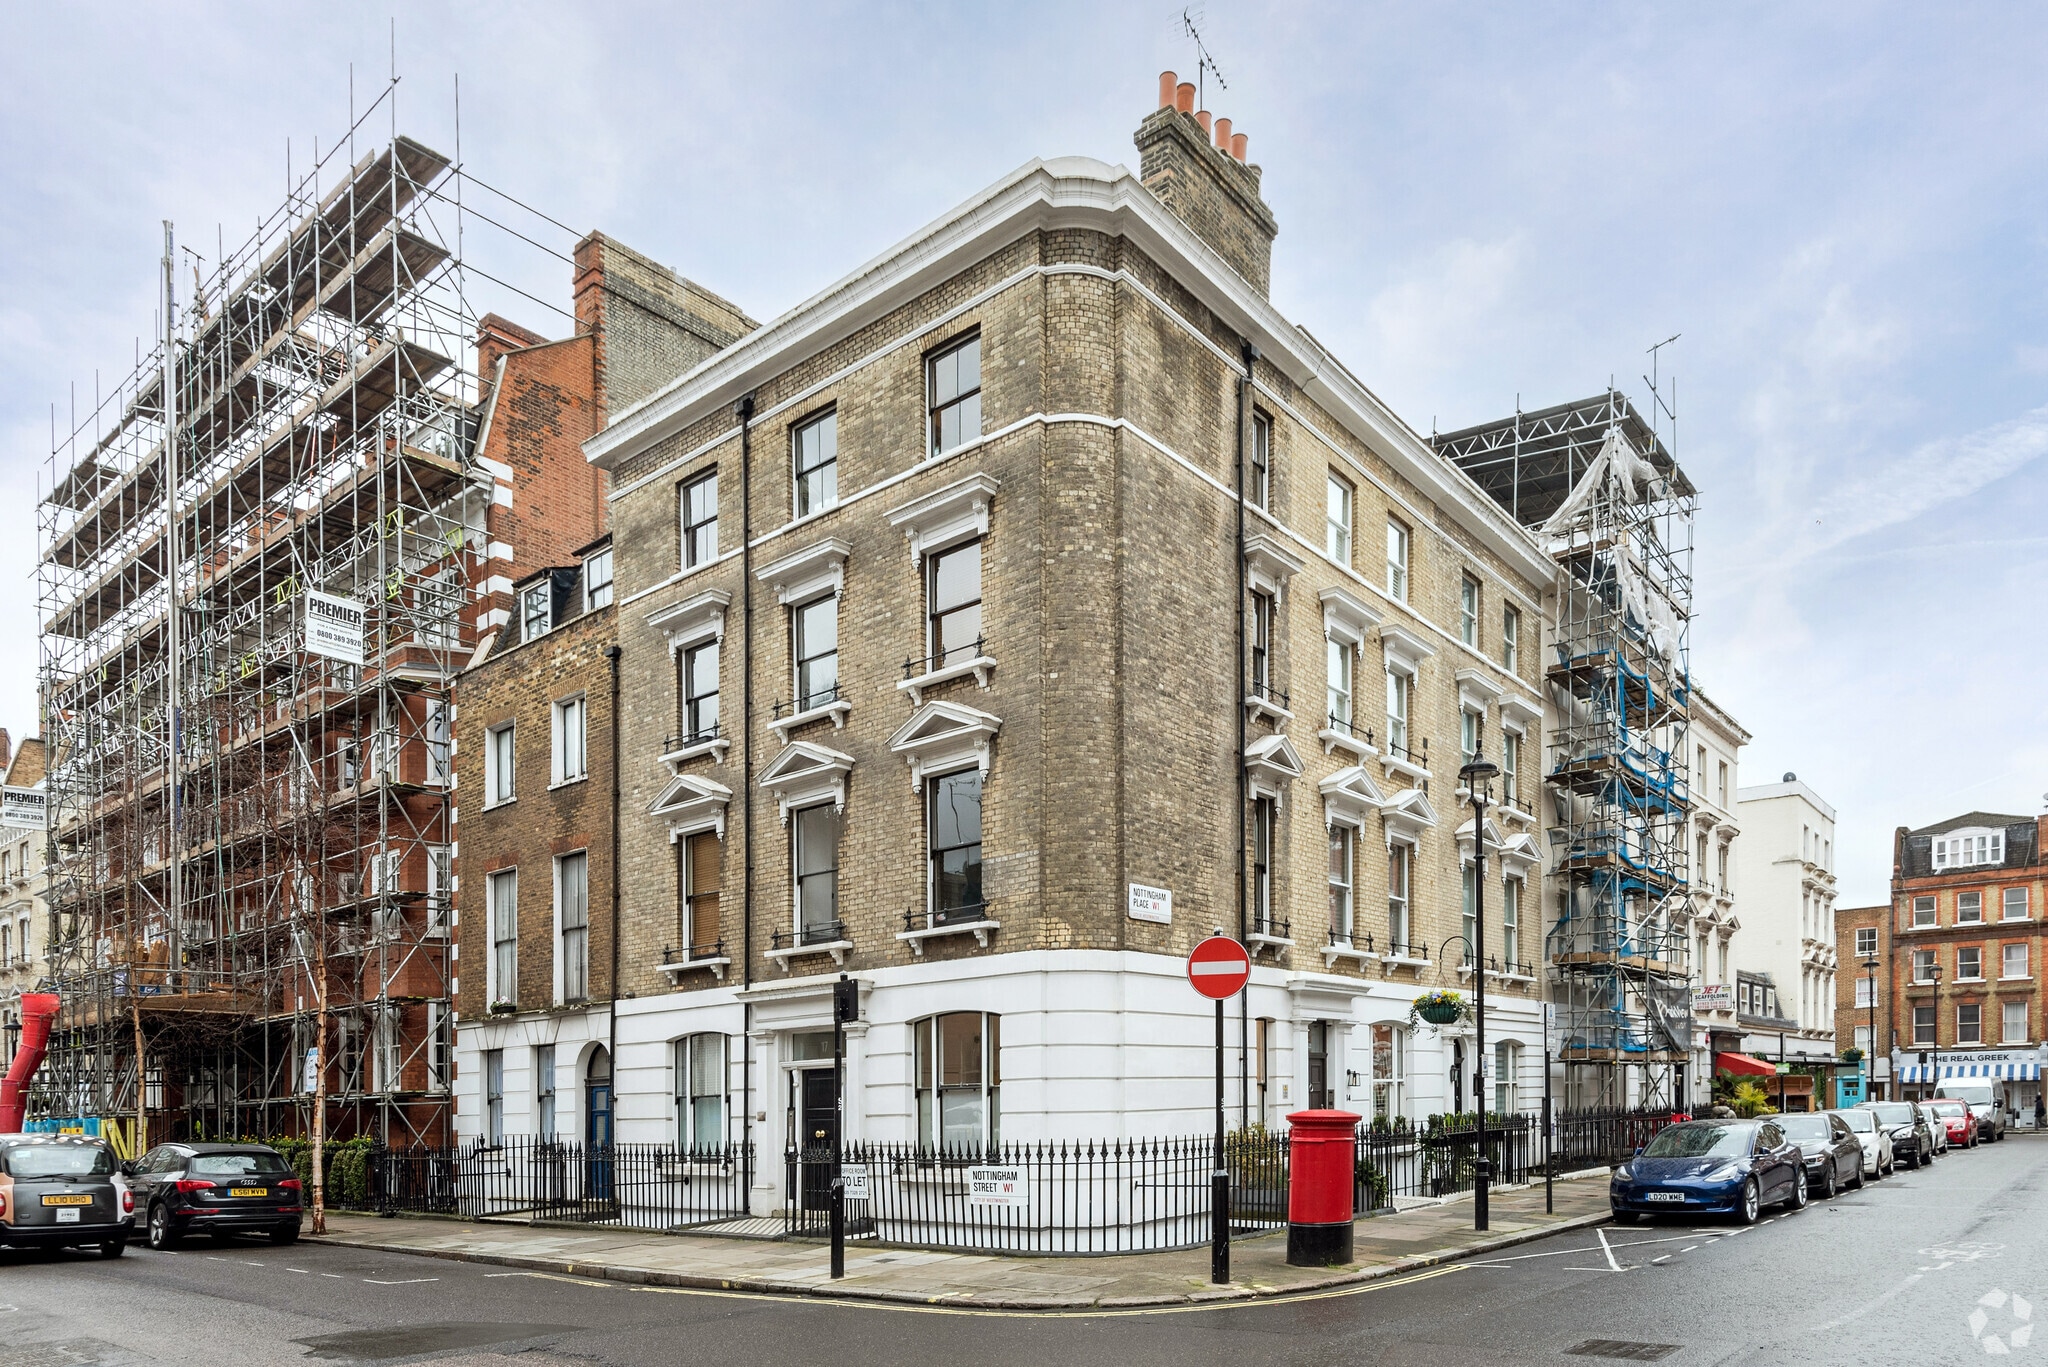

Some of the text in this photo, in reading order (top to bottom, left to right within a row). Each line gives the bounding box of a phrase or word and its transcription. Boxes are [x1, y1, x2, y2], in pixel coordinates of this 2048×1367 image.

[309, 598, 361, 624] PREMIER
[316, 629, 333, 639] 0800
[333, 634, 346, 643] 389
[346, 637, 362, 647] 3920
[4, 792, 45, 804] PREMIER
[1132, 887, 1167, 901] NOTTINGHAM
[1132, 897, 1160, 911] PLACE W1
[1702, 985, 1721, 995] JET
[1929, 1055, 1948, 1063] THE
[1977, 1053, 2010, 1062] GREEK
[972, 1170, 1018, 1181] NOTTINGHAM
[842, 1176, 866, 1187] TO LET
[973, 1182, 1014, 1192] STREET W1
[1649, 1193, 1668, 1201] LD20
